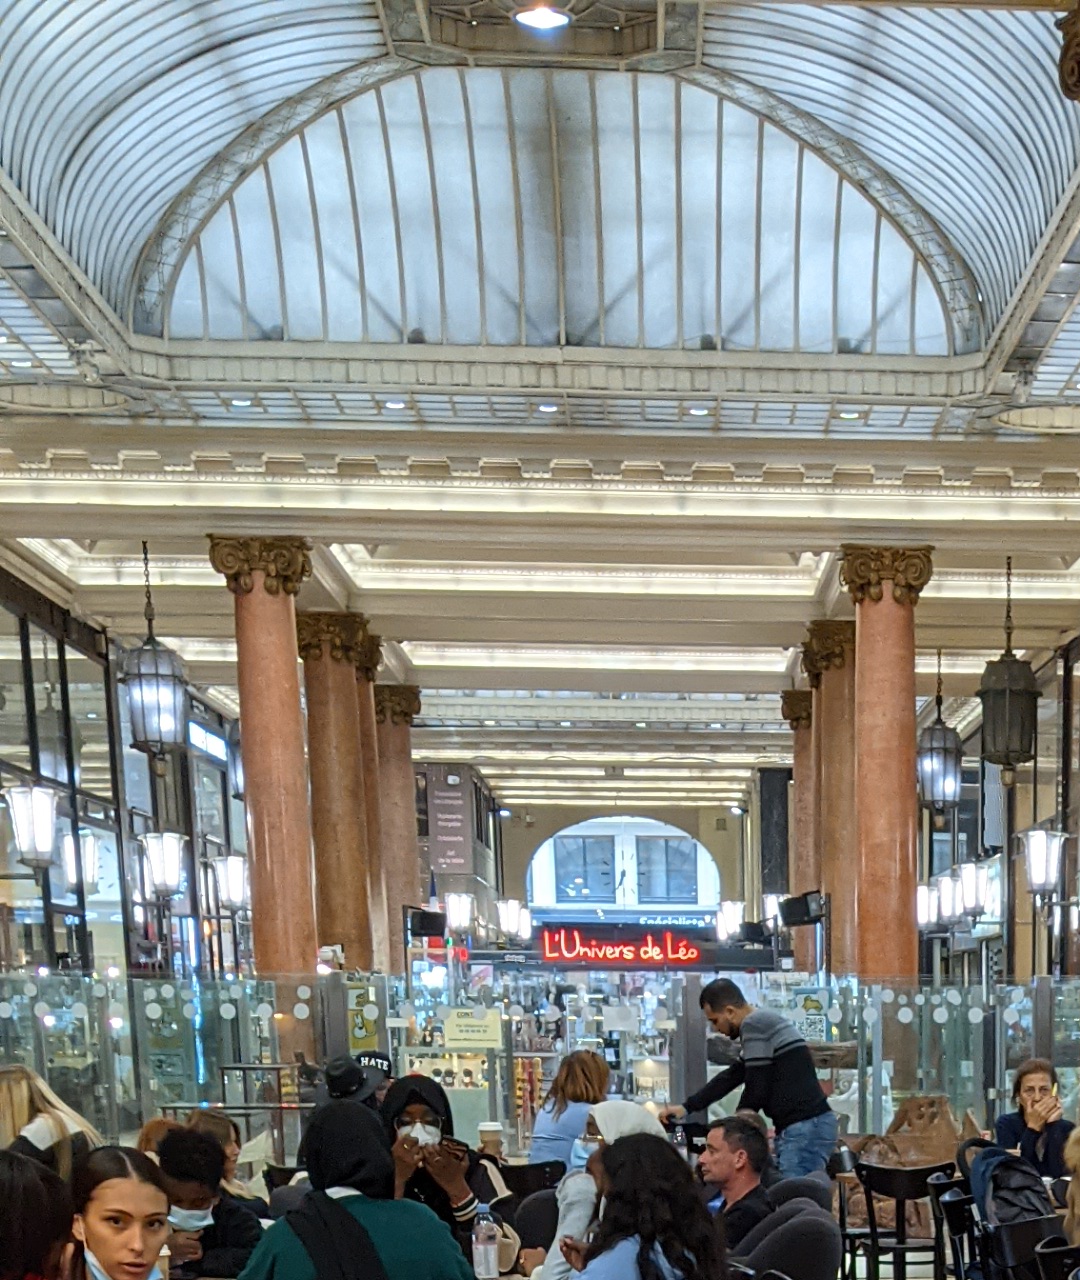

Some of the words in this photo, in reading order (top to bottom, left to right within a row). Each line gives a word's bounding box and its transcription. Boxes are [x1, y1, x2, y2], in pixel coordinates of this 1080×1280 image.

[543, 929, 635, 960] L'Univers
[640, 934, 664, 960] de
[665, 932, 698, 960] Léo
[360, 1056, 389, 1070] HATE
